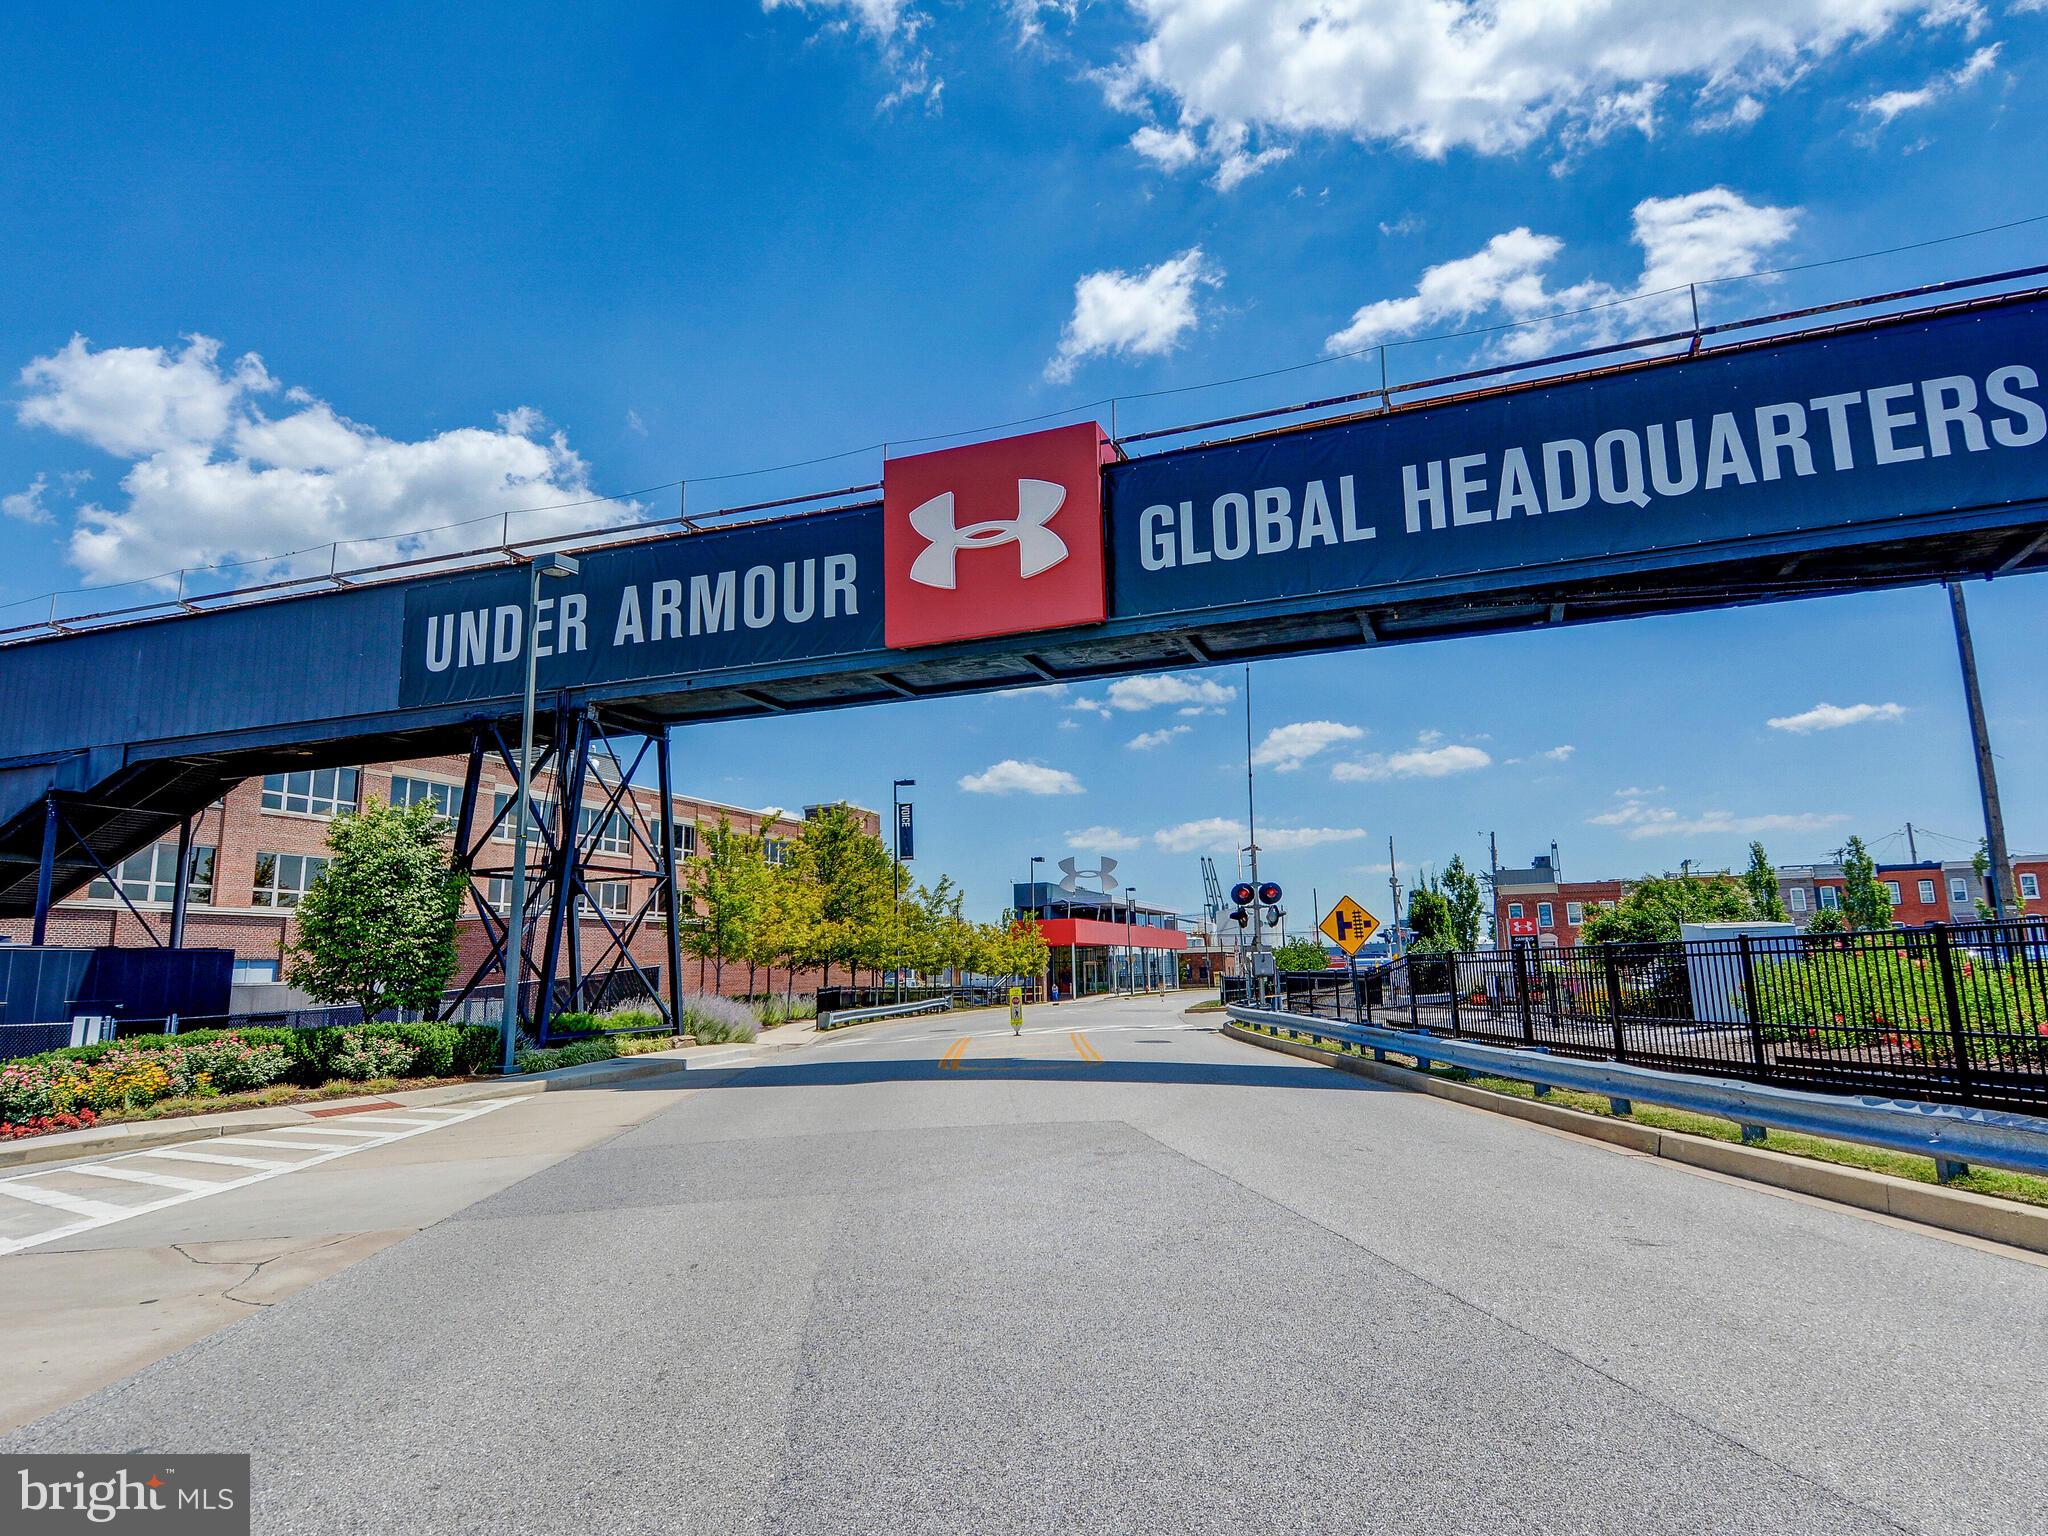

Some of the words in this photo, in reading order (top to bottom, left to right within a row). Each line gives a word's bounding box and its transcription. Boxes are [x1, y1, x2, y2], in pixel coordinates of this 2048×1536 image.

[1139, 475, 1377, 572] GLOBAL
[1402, 365, 2047, 535] HEADQUARTERS
[425, 593, 587, 672] UNDER
[613, 553, 859, 646] ARMOUR
[901, 805, 911, 828] VOICE
